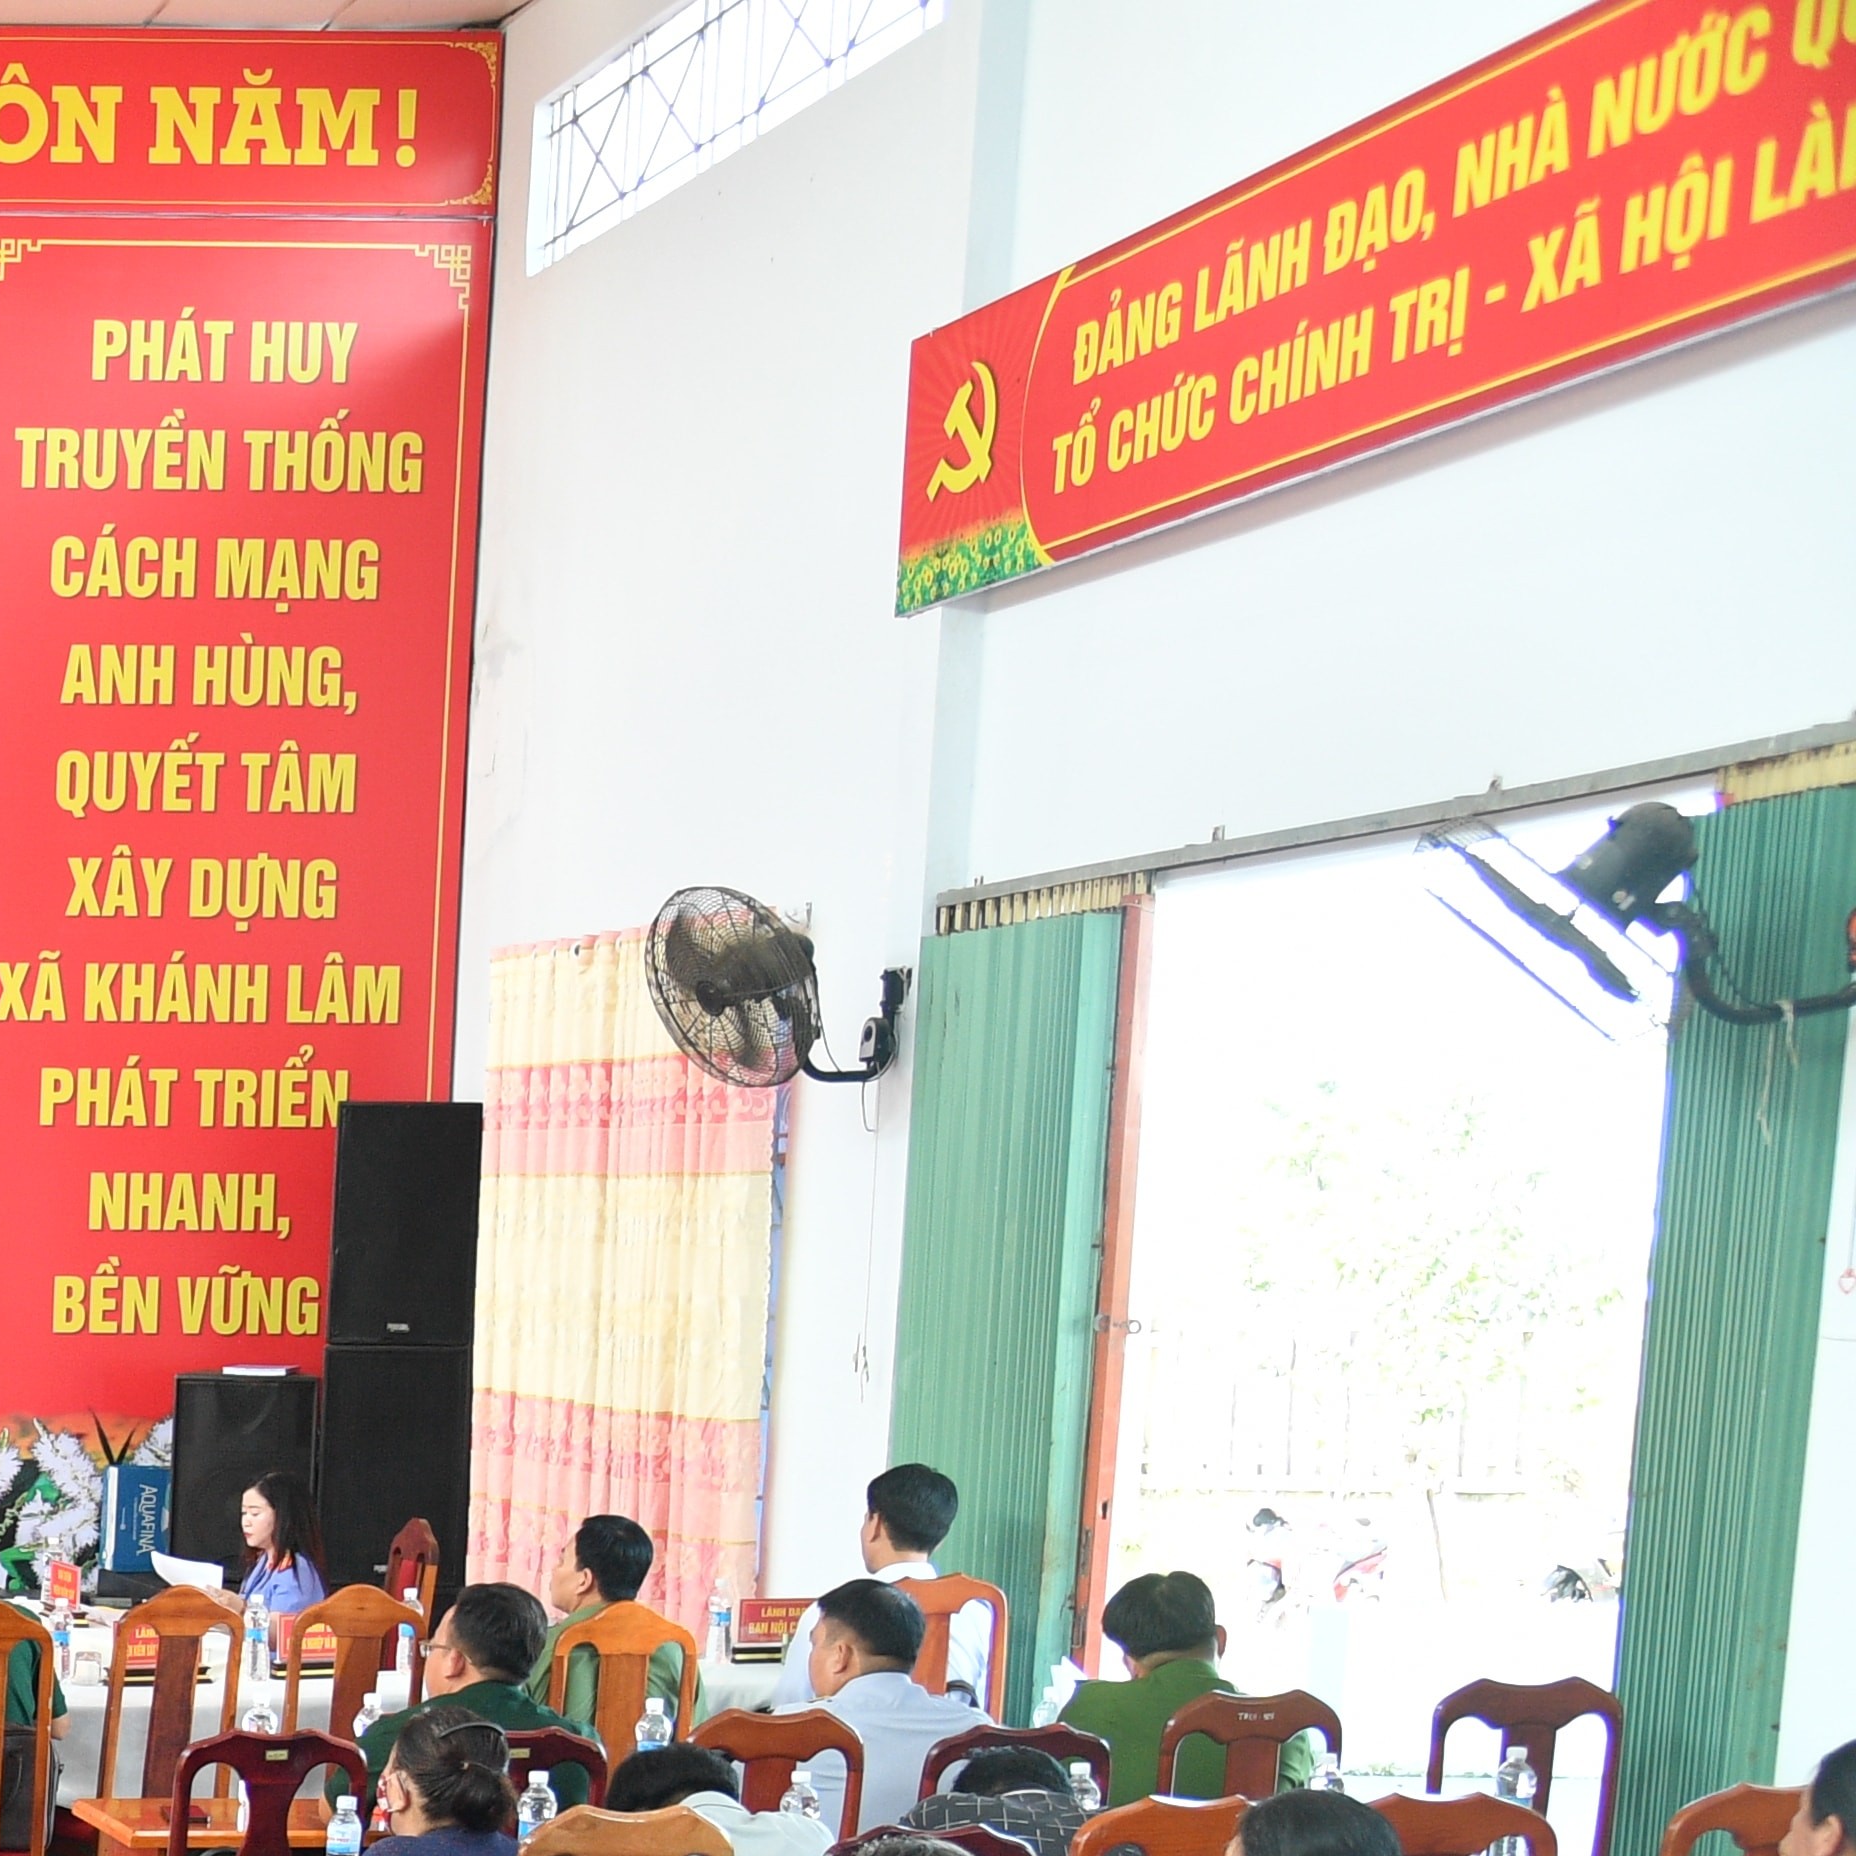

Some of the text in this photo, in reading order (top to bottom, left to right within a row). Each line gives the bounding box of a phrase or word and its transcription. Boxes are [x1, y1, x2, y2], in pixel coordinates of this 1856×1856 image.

[149, 69, 416, 167] NĂM!
[1074, 288, 1184, 385] ĐẢNG
[1194, 218, 1312, 331] LÃNH
[1324, 168, 1435, 274] ĐẠO,
[1453, 86, 1569, 217] NHÀ
[1588, 7, 1771, 157] NƯỚC
[93, 307, 356, 383] PHÁT HUY
[1053, 397, 1101, 493] TỔ
[1108, 372, 1217, 472] CHỨC
[1230, 306, 1374, 424] CHÍNH
[1390, 267, 1470, 362] TRỊ
[1523, 198, 1601, 312] XÃ
[1621, 154, 1733, 273] HỘI
[16, 409, 422, 492] TRUYỀN THỐNG
[51, 524, 378, 612] CÁCH MẠNG
[61, 633, 356, 713] ANH HÙNG,
[56, 733, 356, 817] QUYẾT TÂM
[67, 845, 336, 931] XÂY DỰNG
[85, 951, 268, 1022] KHÁNH
[287, 952, 400, 1023] LÂM
[40, 1045, 348, 1127] PHÁT TRIỂN
[89, 1173, 289, 1238] NHANH,
[53, 1257, 318, 1334] BỀN VỮNG
[136, 1484, 159, 1556] AQUAFINA
